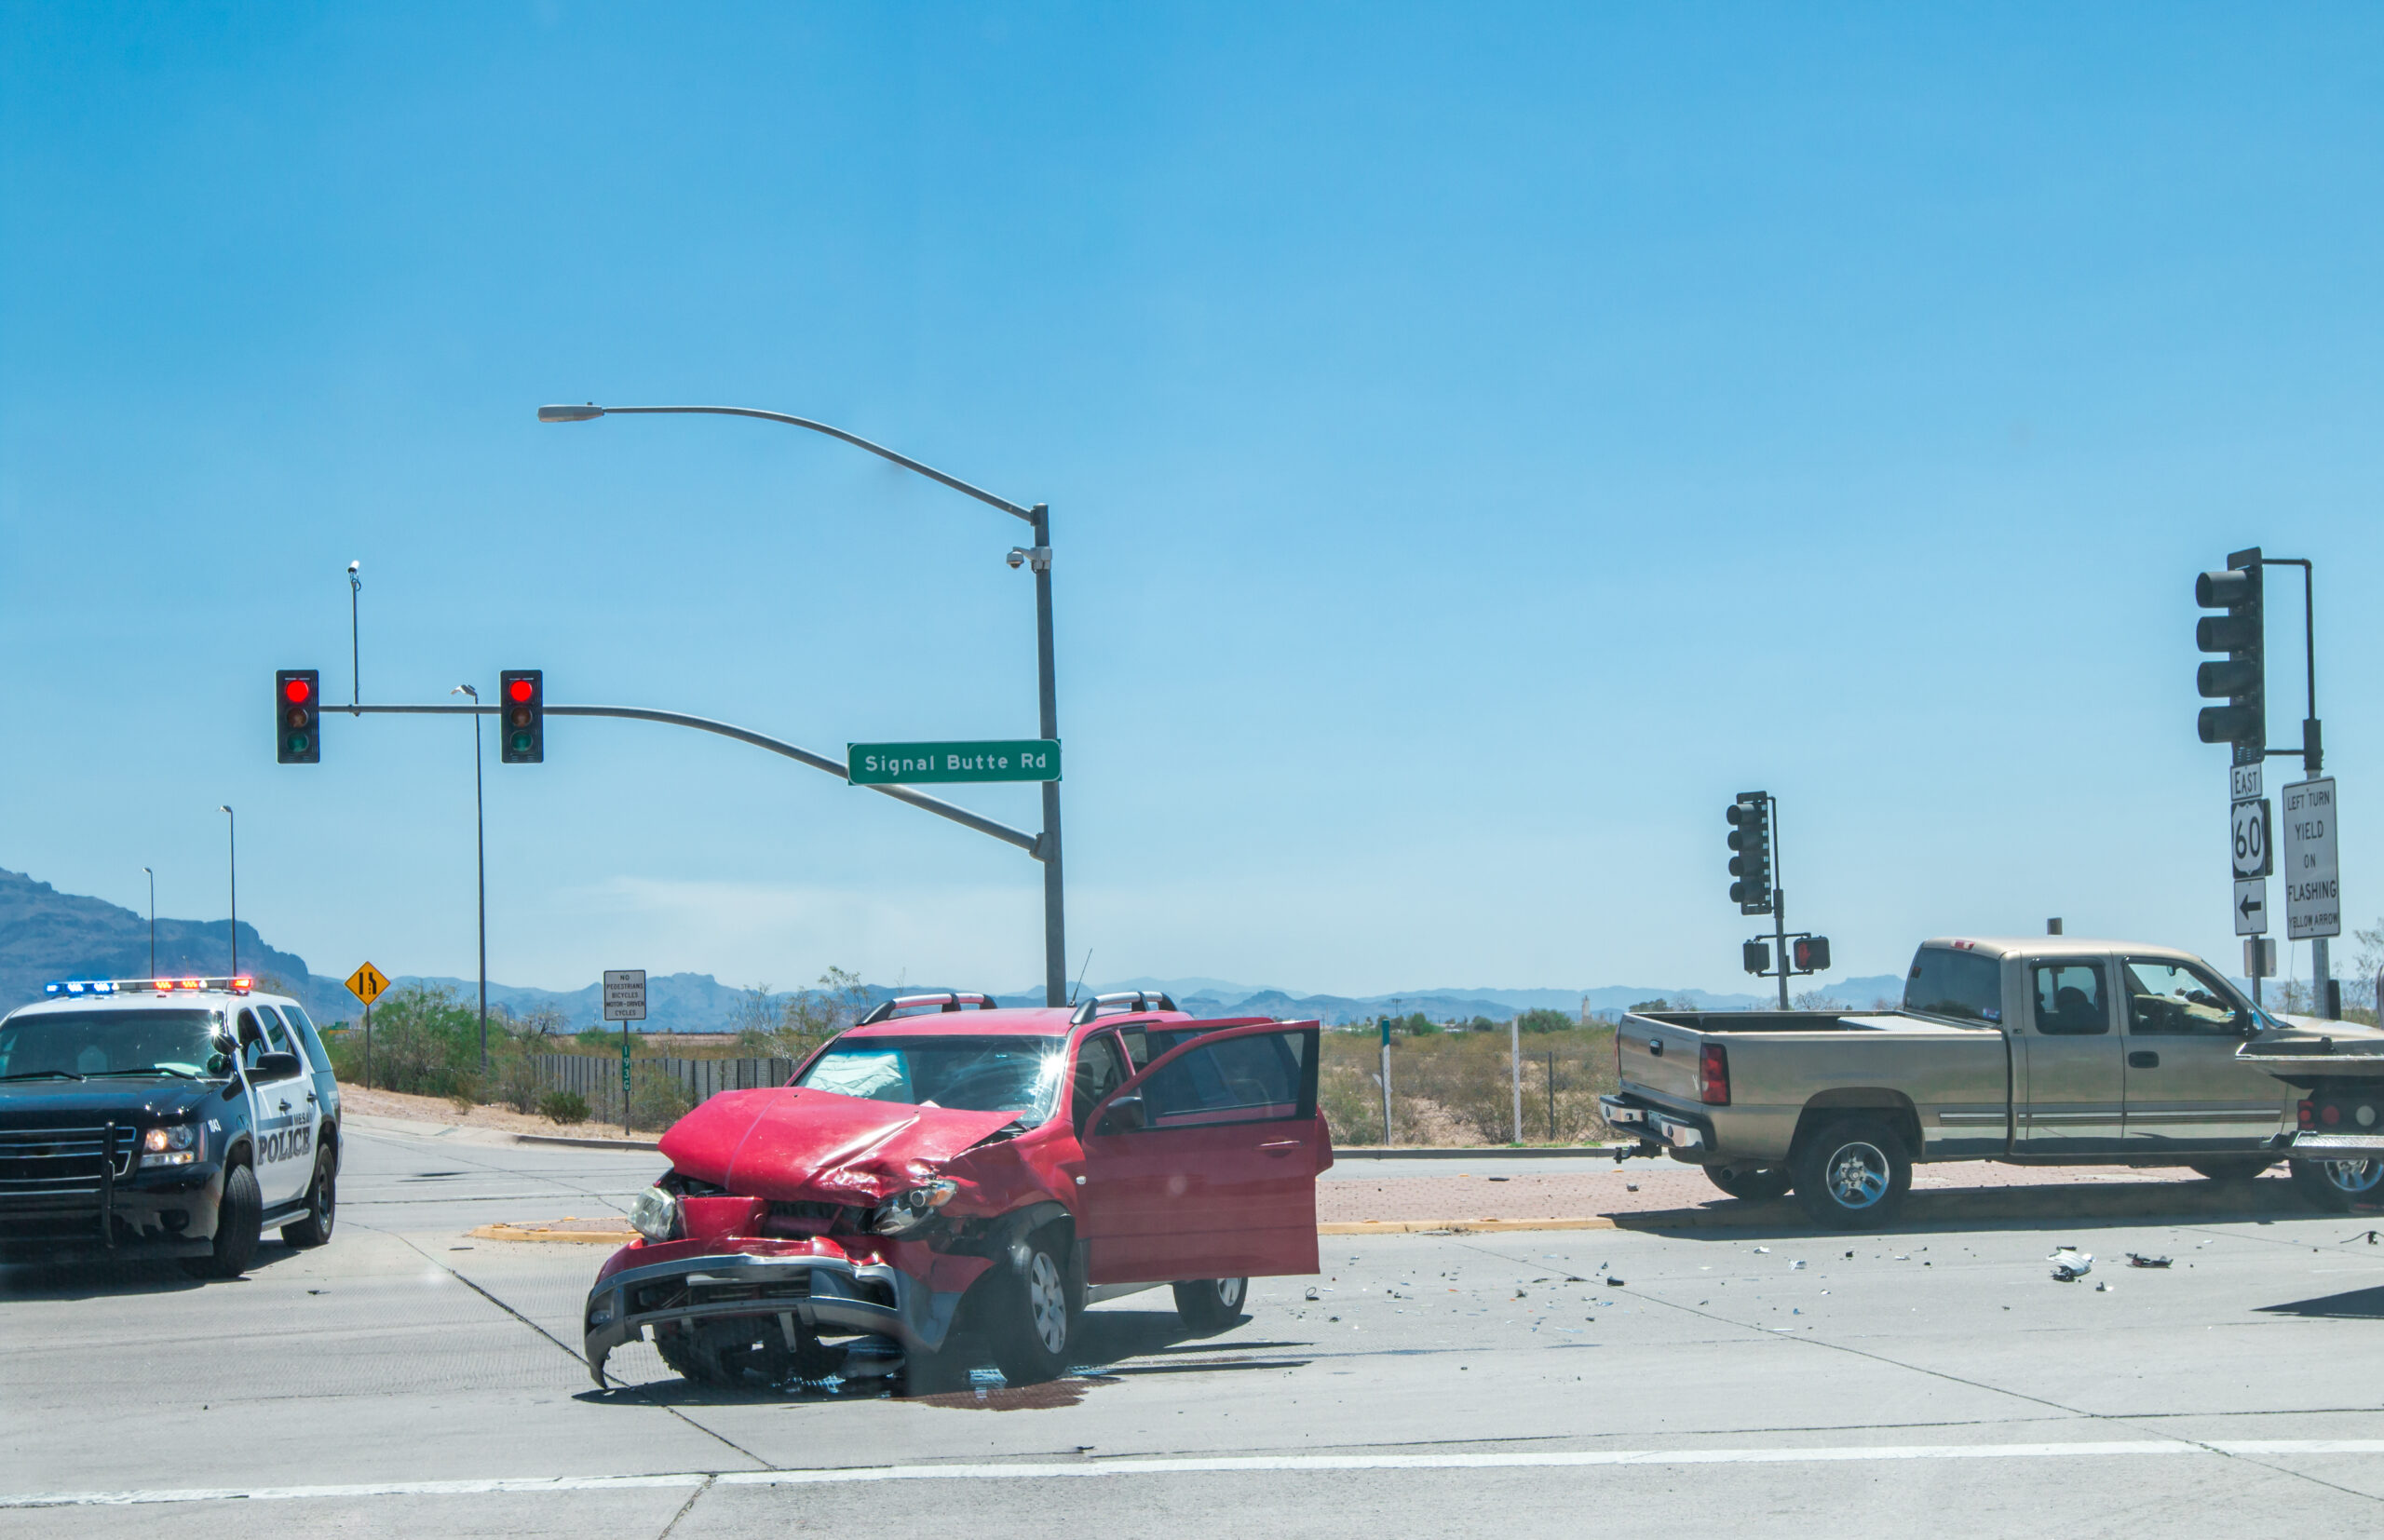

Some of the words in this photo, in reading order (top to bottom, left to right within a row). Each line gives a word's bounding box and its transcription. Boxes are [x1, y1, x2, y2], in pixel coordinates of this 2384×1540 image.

[864, 754, 935, 777] Signal
[946, 753, 1009, 771] Butte
[1021, 752, 1047, 769] Rd
[2235, 771, 2257, 795] EAST
[2287, 794, 2305, 811] LEFT
[2309, 790, 2330, 808] TURN
[2235, 816, 2261, 859] 60
[2295, 819, 2324, 842] YIELD
[2304, 853, 2316, 870] ON
[2288, 880, 2337, 902] FLASHING
[2288, 914, 2313, 928] YELLOW
[2314, 912, 2338, 925] ARROW
[256, 1126, 312, 1167] POLICE
